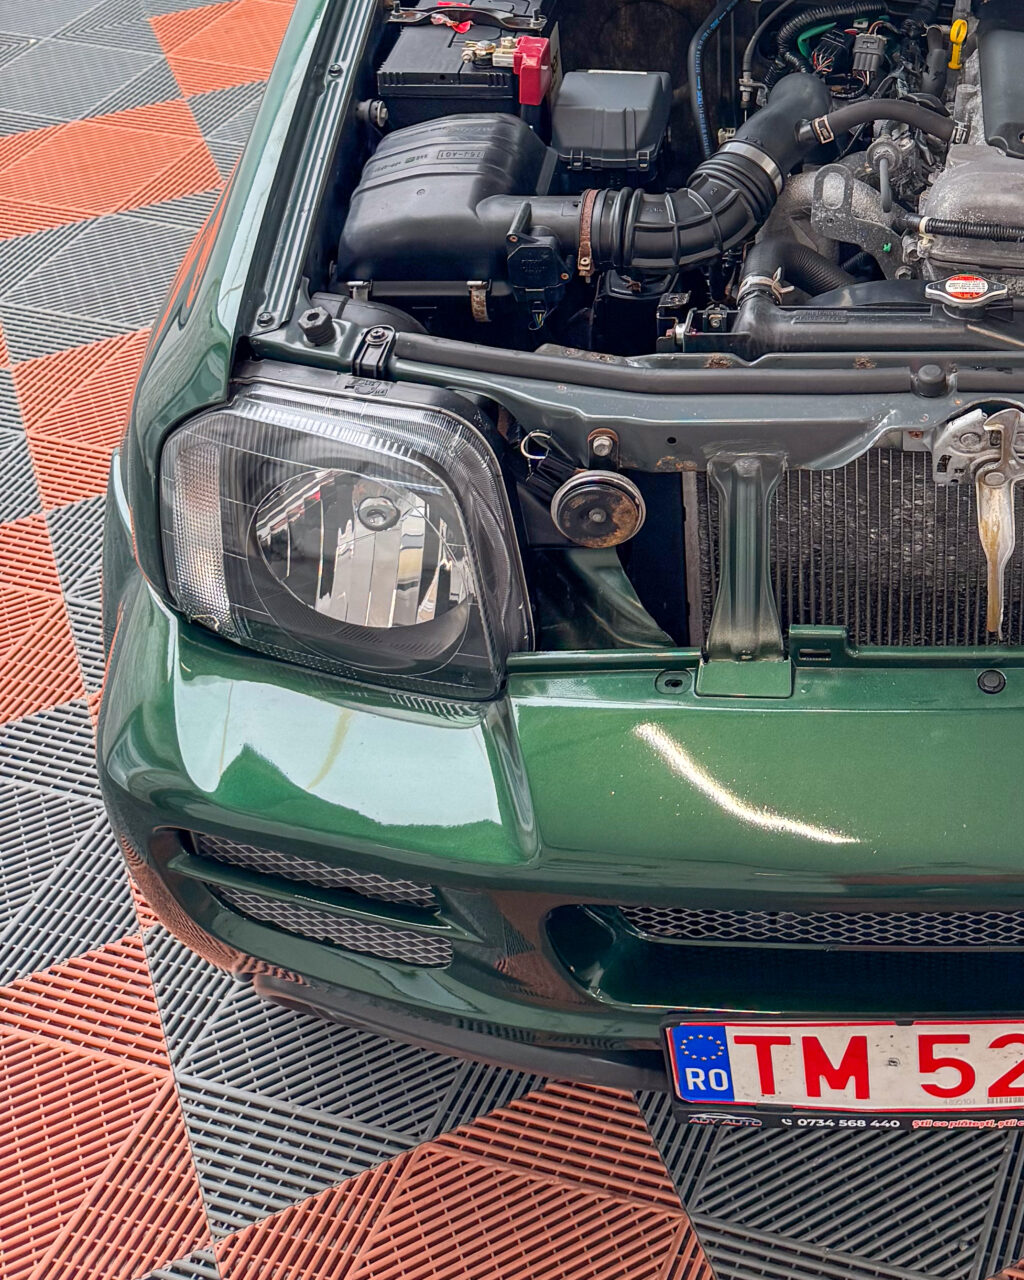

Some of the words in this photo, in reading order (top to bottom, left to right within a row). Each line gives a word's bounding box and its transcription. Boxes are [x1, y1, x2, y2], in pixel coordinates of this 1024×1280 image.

[685, 1067, 728, 1091] RO
[733, 1035, 870, 1099] TM
[688, 1116, 718, 1124] ADY
[721, 1118, 763, 1127] AUTO
[797, 1118, 835, 1127] 0734
[838, 1119, 866, 1127] 568
[869, 1119, 900, 1128] 440
